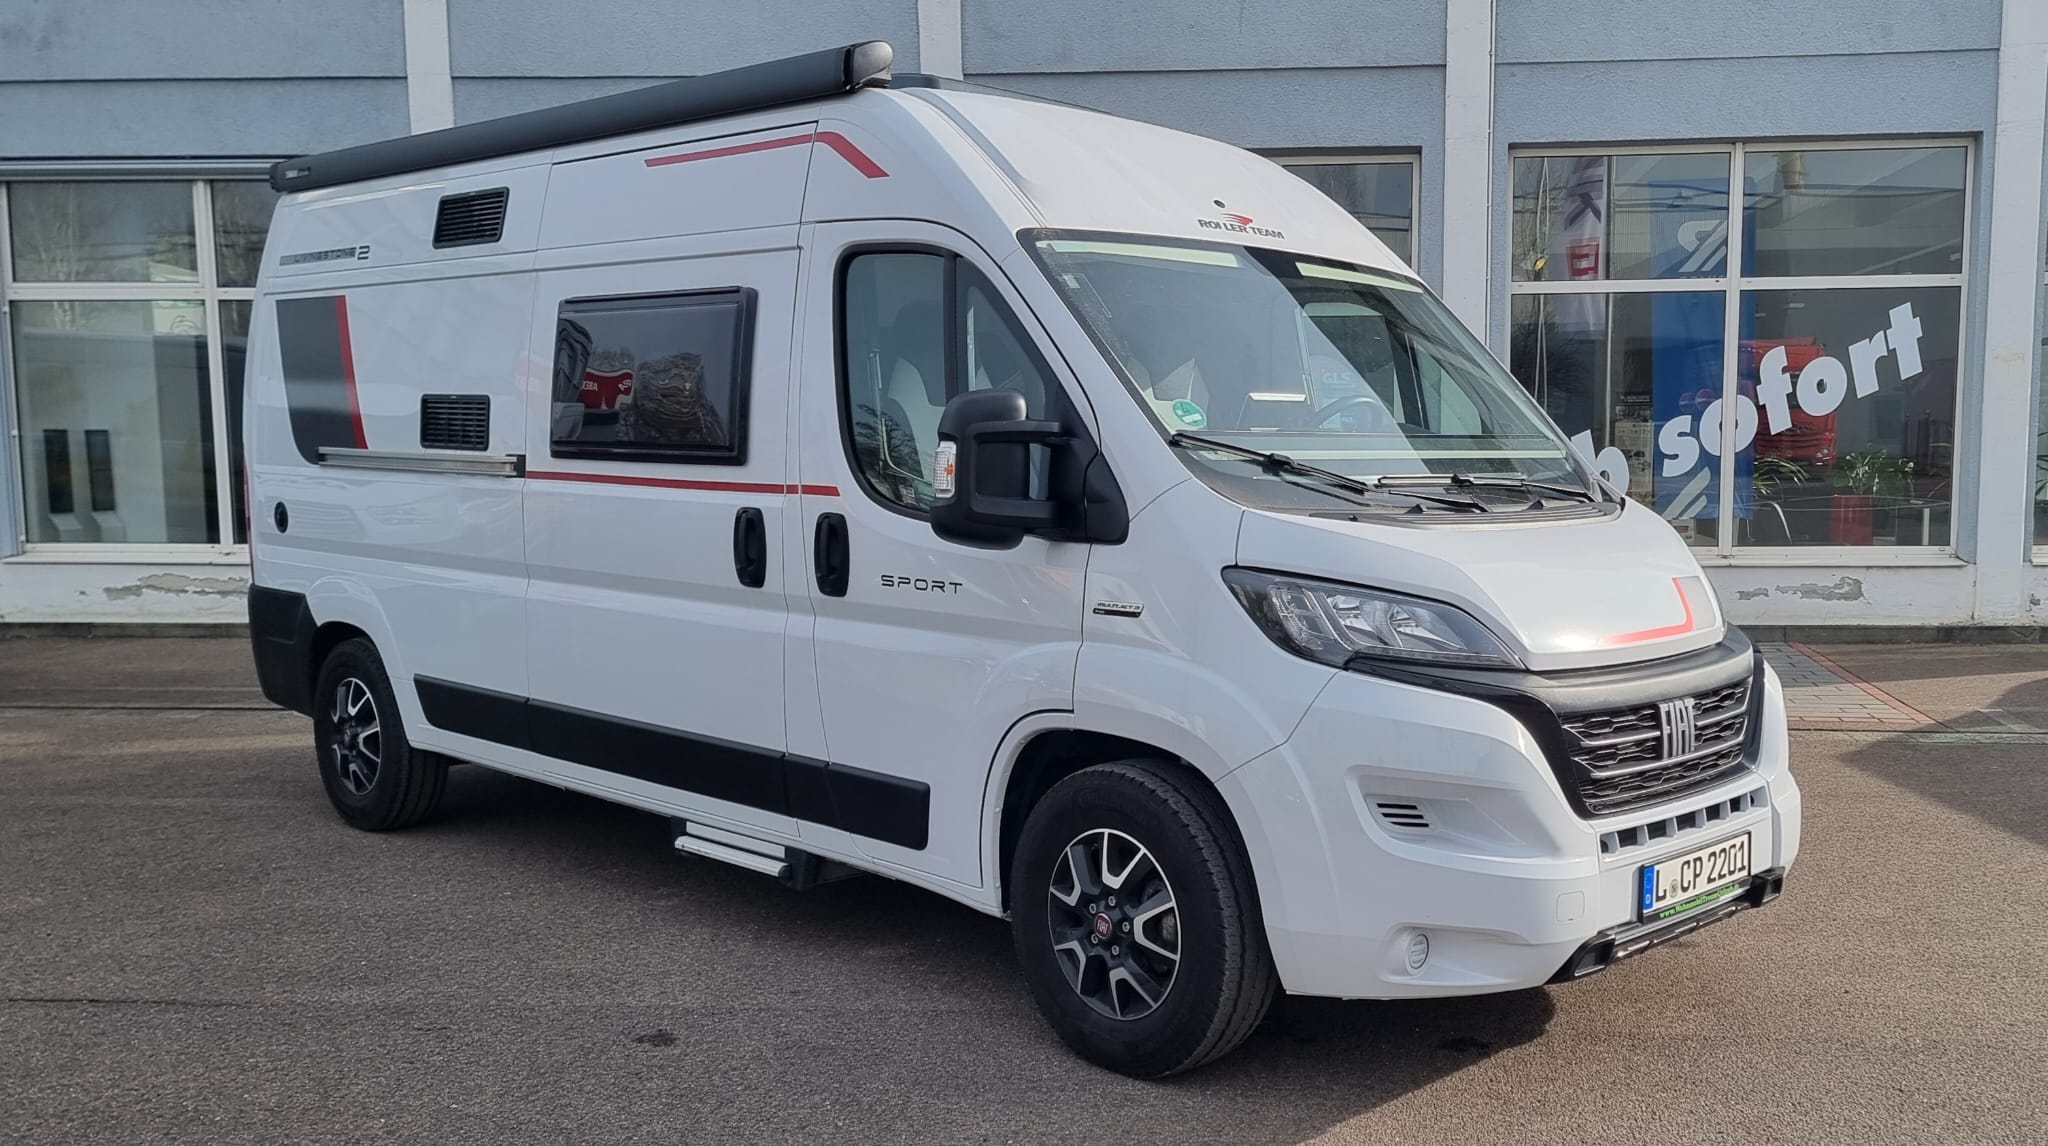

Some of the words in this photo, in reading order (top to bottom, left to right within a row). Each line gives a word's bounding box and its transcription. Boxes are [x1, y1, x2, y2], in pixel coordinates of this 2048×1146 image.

[1249, 226, 1285, 240] TEAM
[357, 245, 370, 260] 2
[1658, 301, 1923, 478] sofort
[881, 574, 963, 595] SPORT
[1659, 698, 1695, 760] FIAT
[1655, 869, 1667, 902] L
[1680, 856, 1704, 893] CP
[1706, 841, 1746, 884] 2201
[1096, 919, 1108, 934] FIAT
